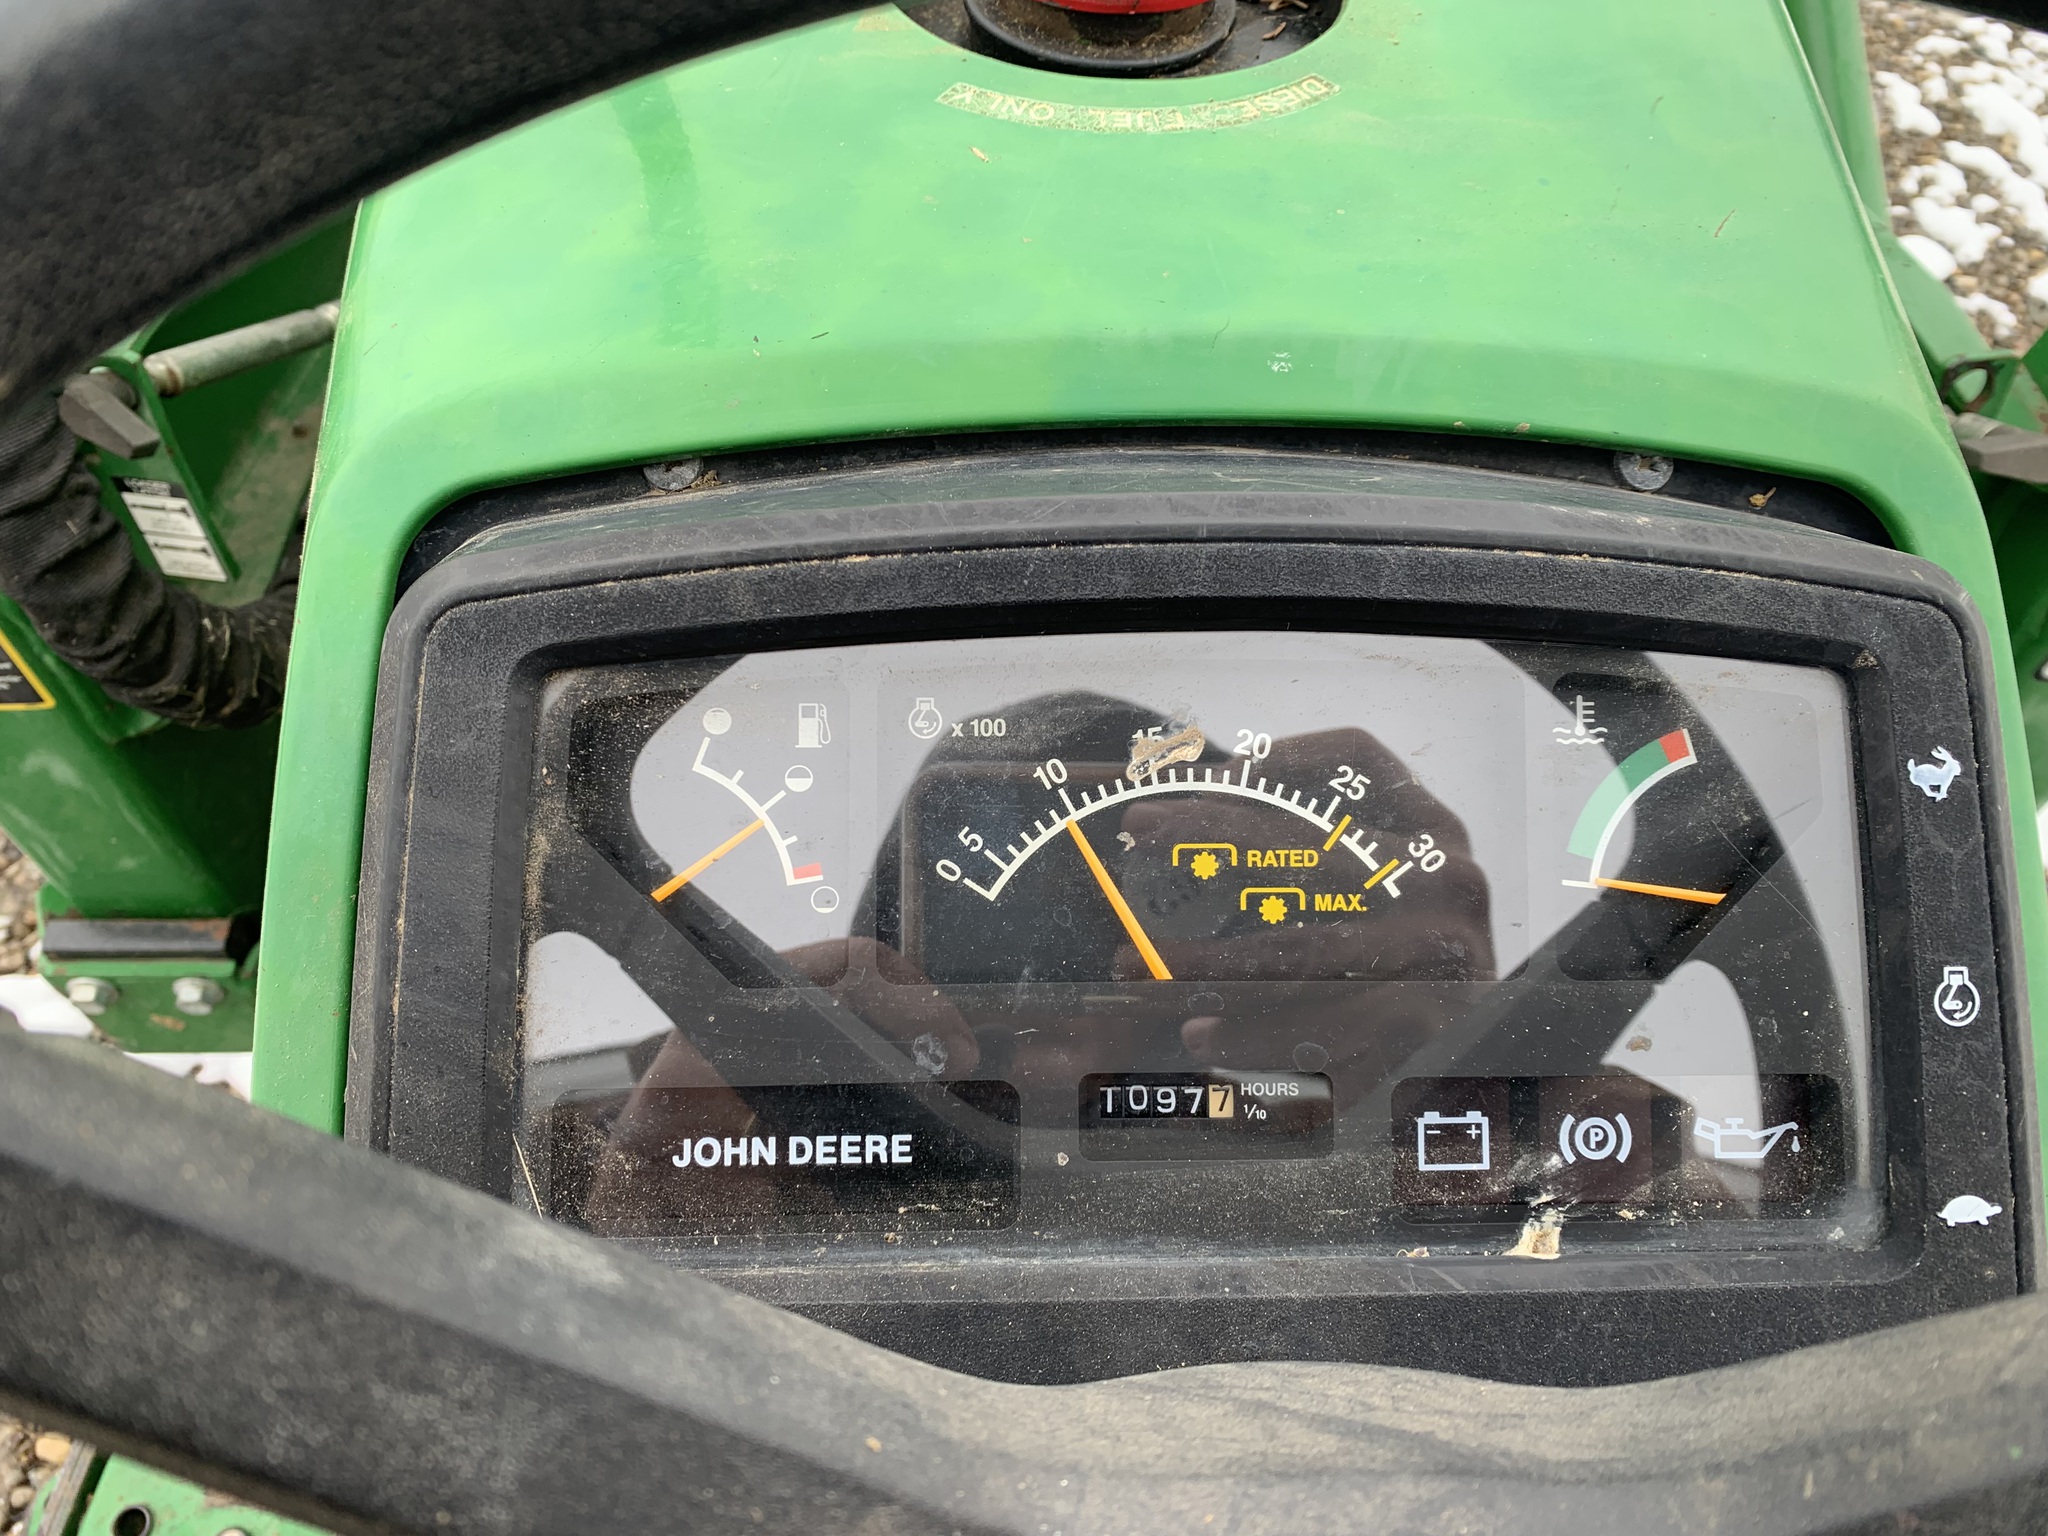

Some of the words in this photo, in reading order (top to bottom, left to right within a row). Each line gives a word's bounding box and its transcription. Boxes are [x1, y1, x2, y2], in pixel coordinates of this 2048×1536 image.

[970, 718, 1007, 738] 100
[1235, 728, 1273, 760] 20
[1032, 758, 1070, 790] 10
[1327, 764, 1372, 802] 25
[959, 826, 985, 853] 5
[1246, 849, 1320, 869] RATED
[1407, 833, 1448, 874] 30
[934, 858, 964, 883] 0
[1314, 893, 1368, 913] MAX.
[1240, 1082, 1300, 1097] HOURS
[1243, 1103, 1267, 1120] 1/10
[672, 1136, 778, 1168] JOHN
[788, 1134, 914, 1167] DEERE
